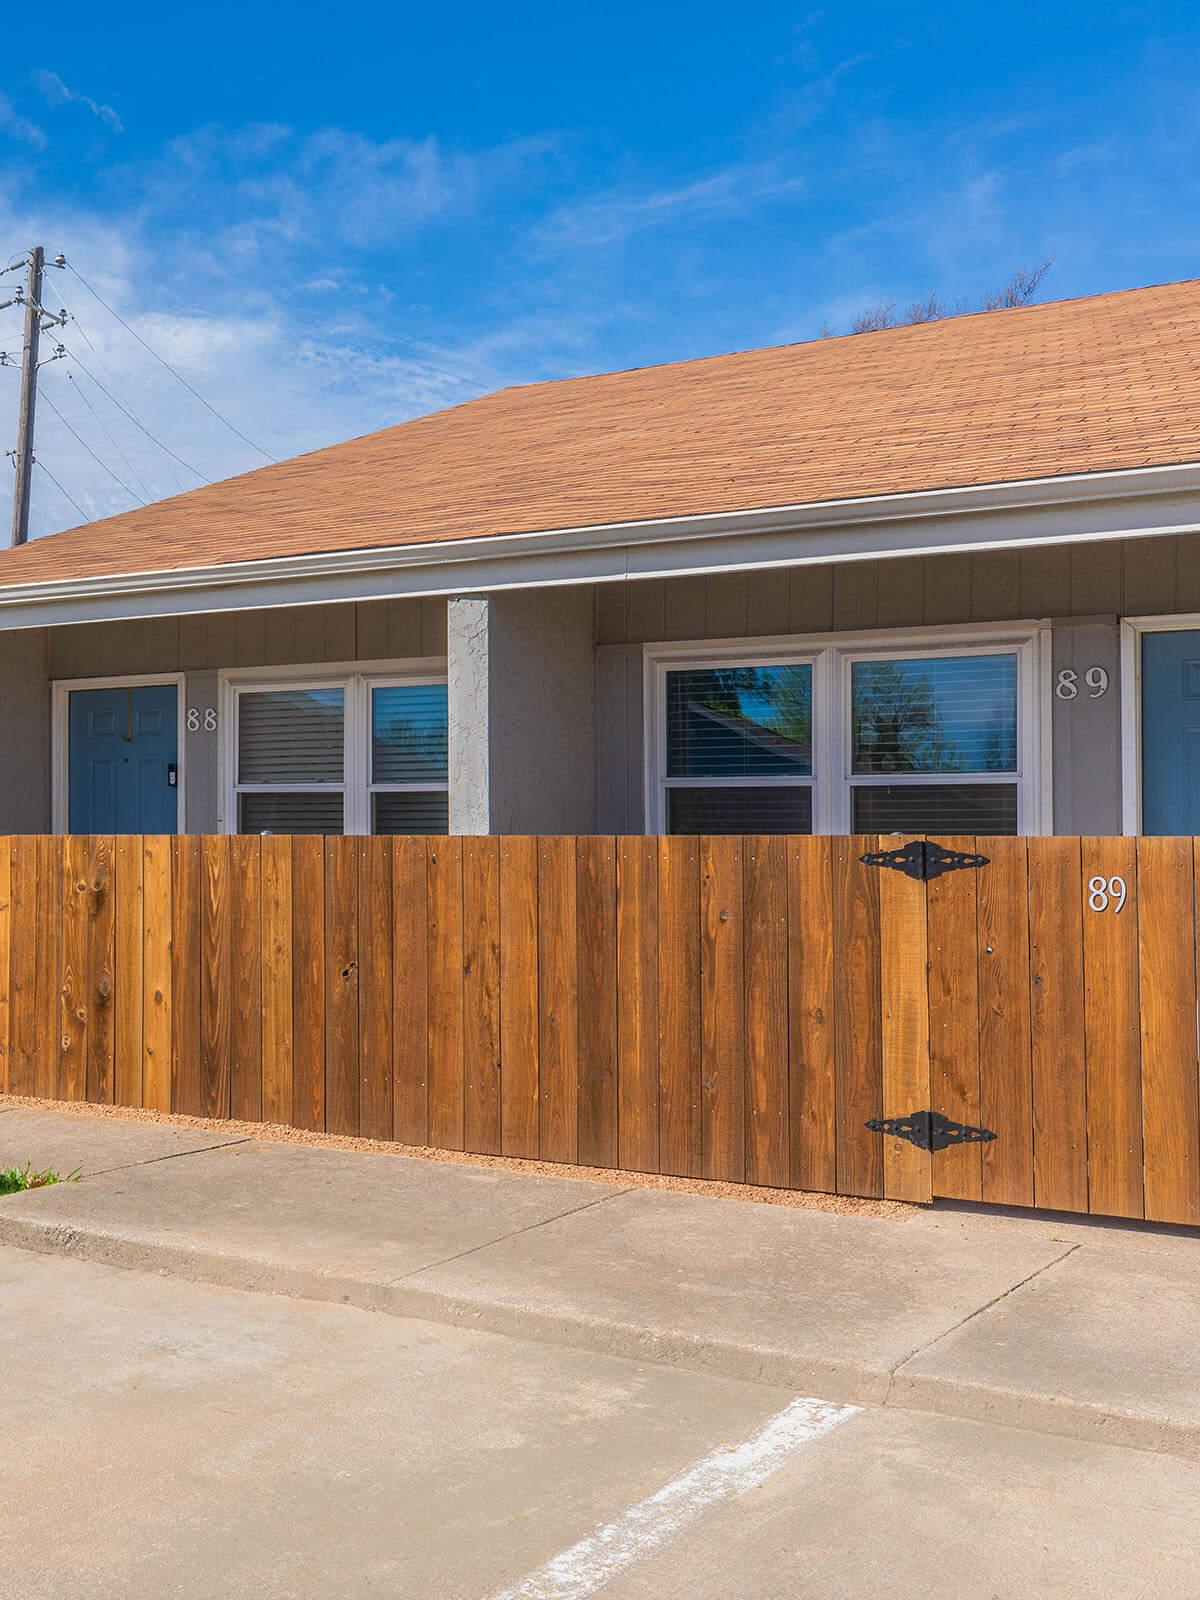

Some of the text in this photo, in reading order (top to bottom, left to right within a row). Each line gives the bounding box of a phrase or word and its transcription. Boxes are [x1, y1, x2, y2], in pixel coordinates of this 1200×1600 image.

[1056, 667, 1109, 700] 89
[187, 708, 217, 732] 88
[1088, 876, 1127, 914] 89
